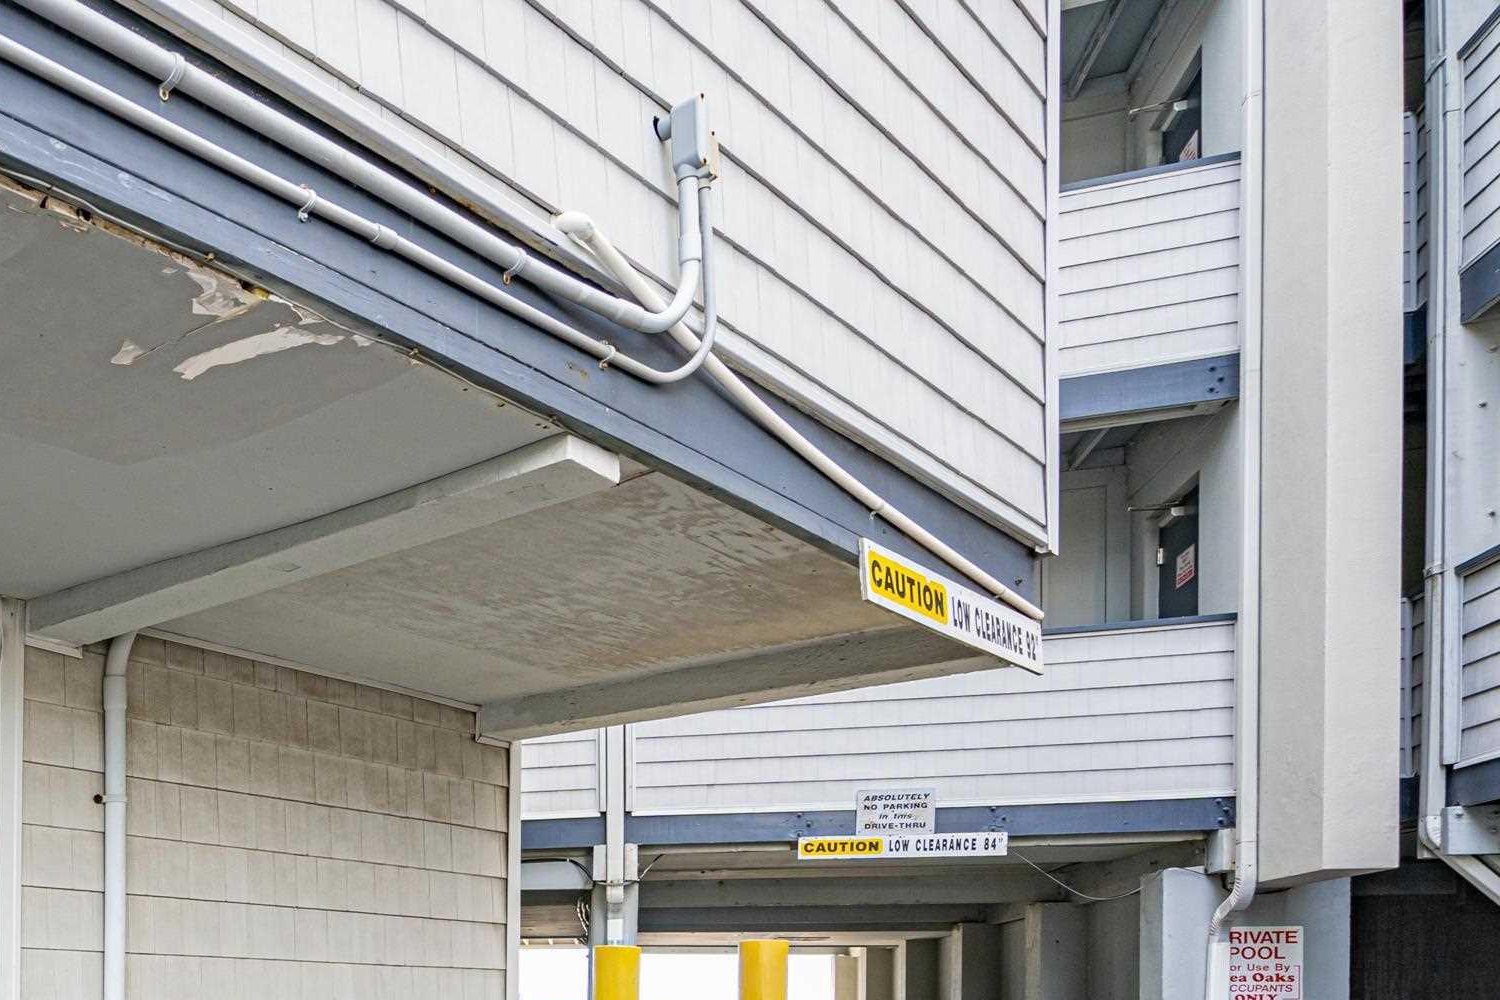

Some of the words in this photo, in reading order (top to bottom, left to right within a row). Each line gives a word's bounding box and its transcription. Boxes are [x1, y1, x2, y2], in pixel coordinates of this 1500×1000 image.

[871, 559, 945, 618] CAUTION
[951, 596, 971, 633] LOW
[975, 606, 1024, 655] CLEARANCE
[863, 792, 931, 802] ABSOLUTELY
[883, 802, 928, 810] PARKING
[893, 812, 913, 820] this
[864, 821, 927, 830] DRIVE-THRU
[803, 839, 880, 853] CAUTION
[889, 838, 911, 852] LOW
[915, 837, 977, 852] CLEARANCE
[1229, 930, 1299, 944] RIVATE
[1247, 963, 1270, 972] Use
[1275, 963, 1291, 973] By
[1230, 974, 1247, 983] ea
[1252, 972, 1295, 983] Oaks
[1229, 984, 1293, 993] CCUPANTS
